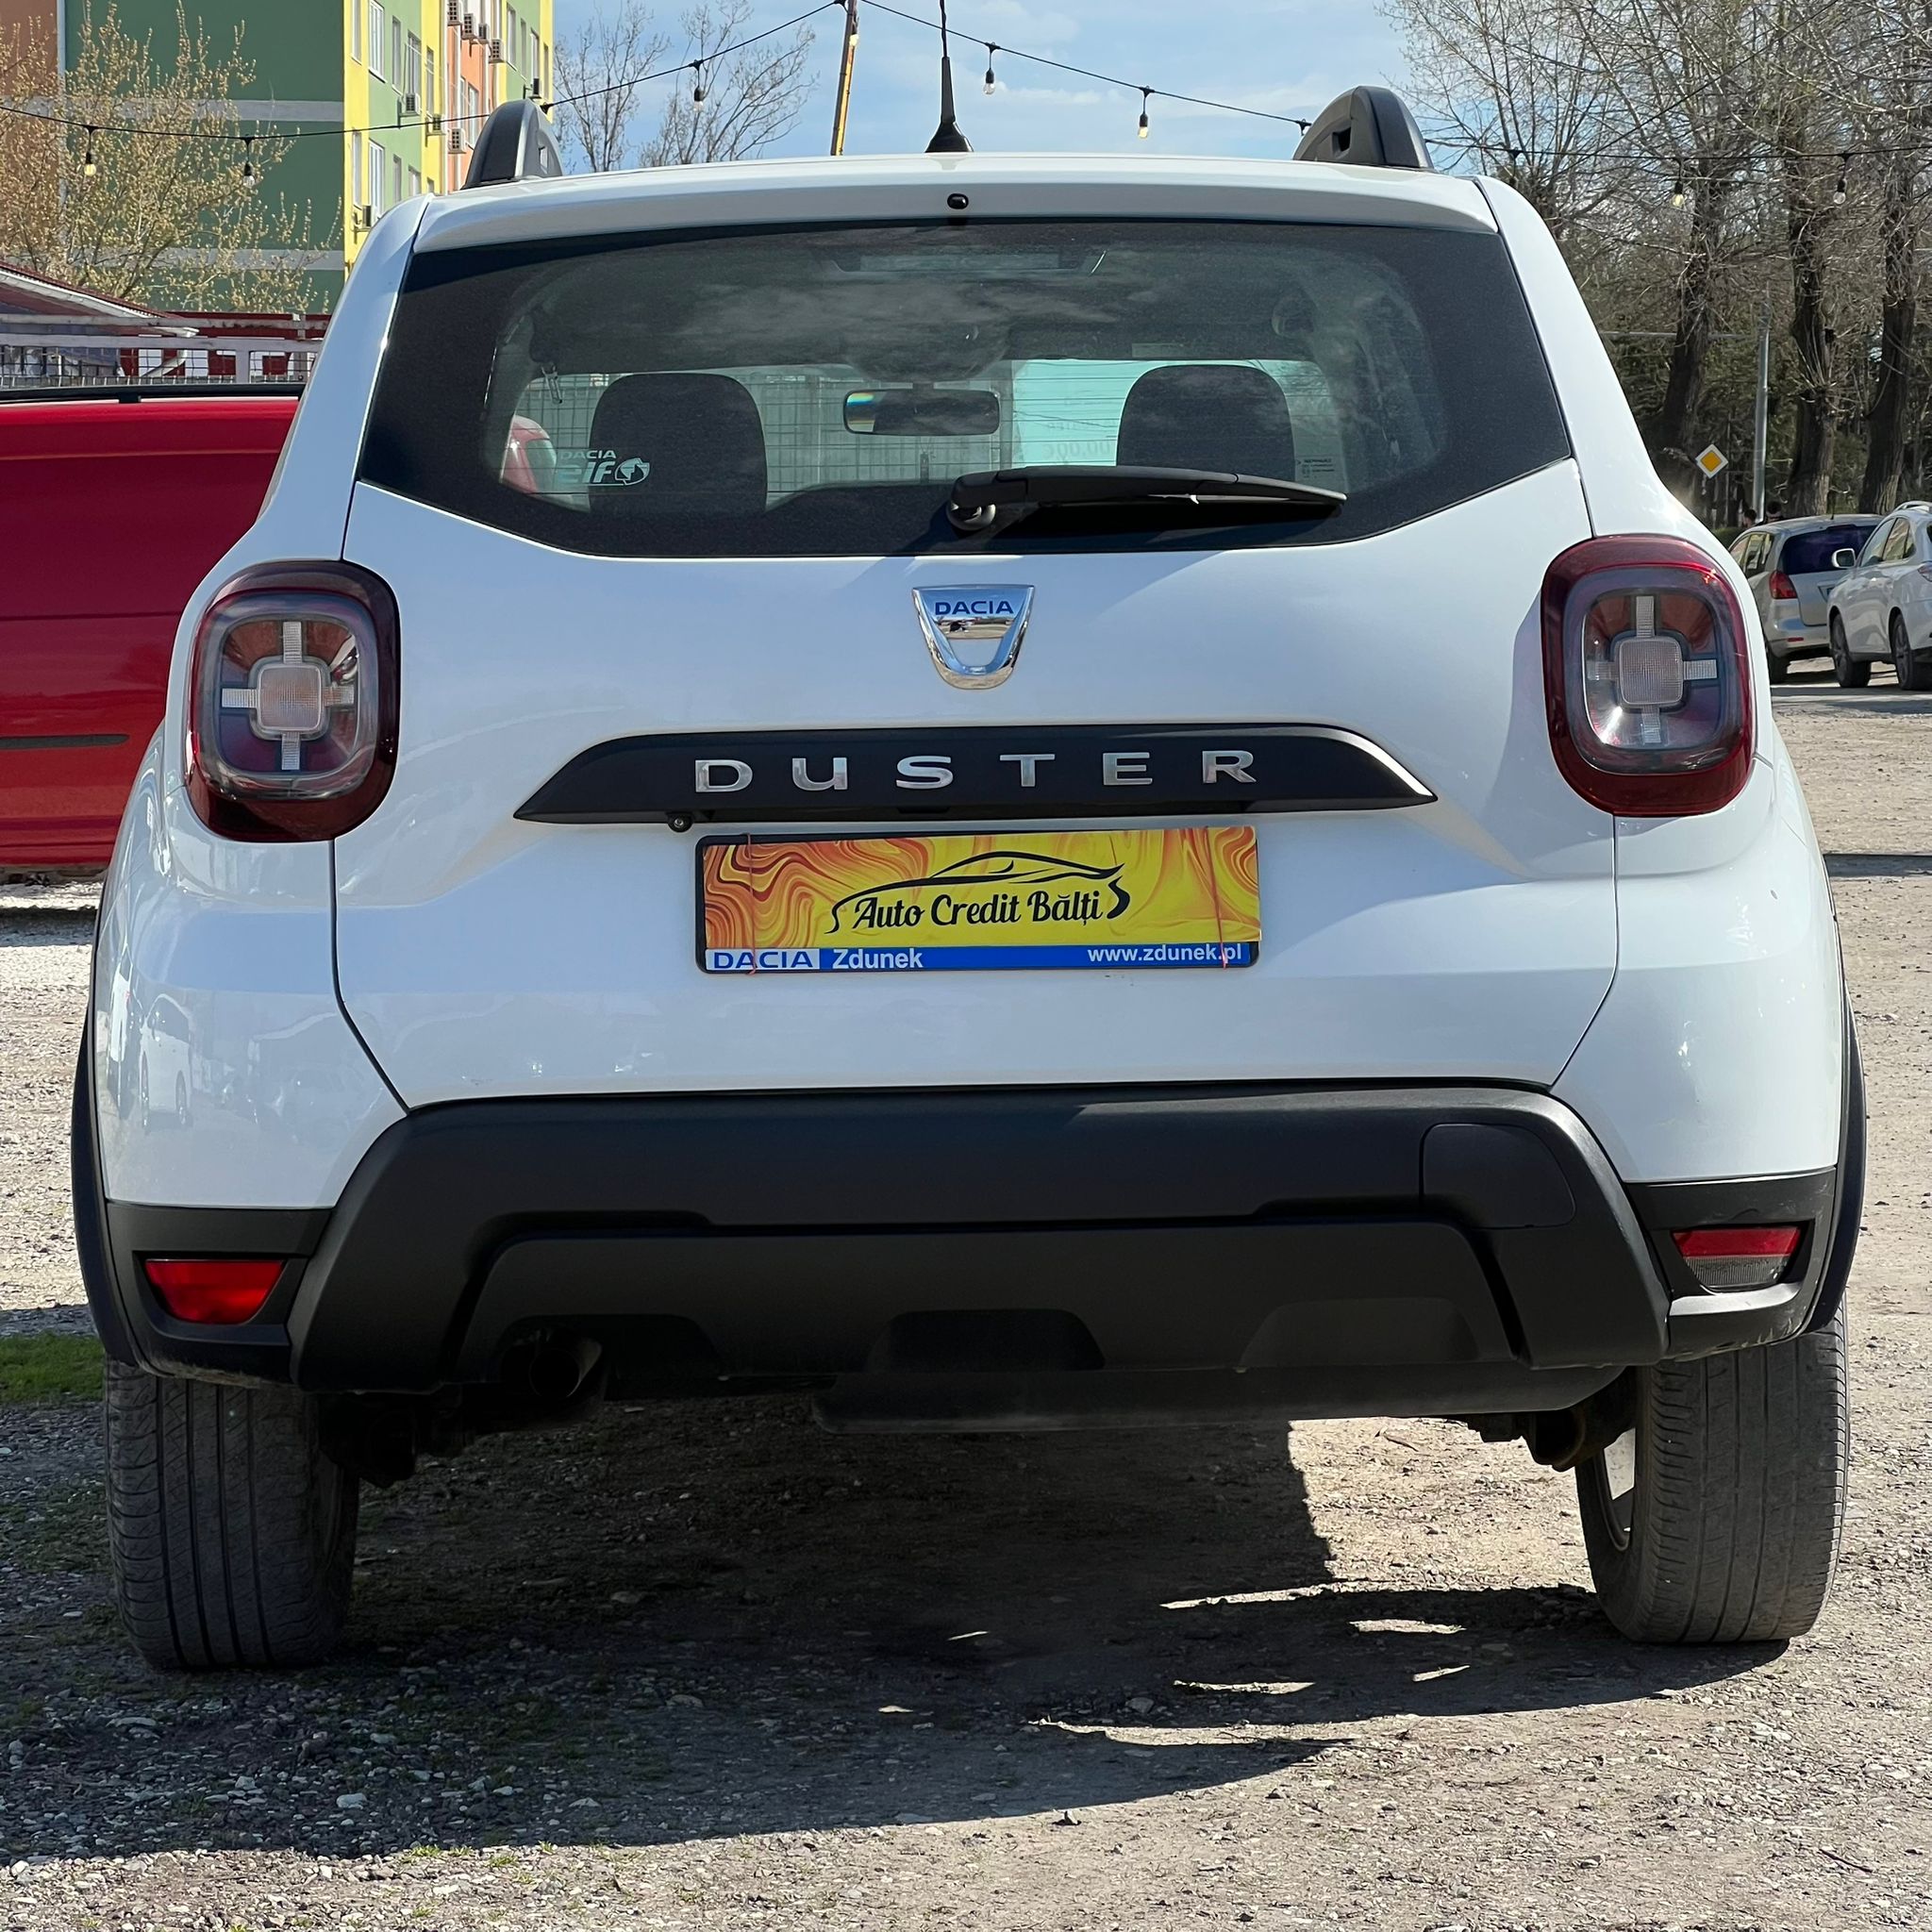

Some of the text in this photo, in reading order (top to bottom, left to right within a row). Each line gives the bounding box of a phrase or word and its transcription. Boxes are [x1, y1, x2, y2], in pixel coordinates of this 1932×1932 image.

[559, 449, 618, 460] DACIA
[935, 600, 1014, 616] DACIA
[694, 750, 1257, 793] DUSTER
[852, 896, 925, 929] Auto
[930, 893, 1022, 926] Credit
[713, 948, 924, 970] DACIA Zdunek
[1087, 943, 1242, 964] www.zdunek.pl
